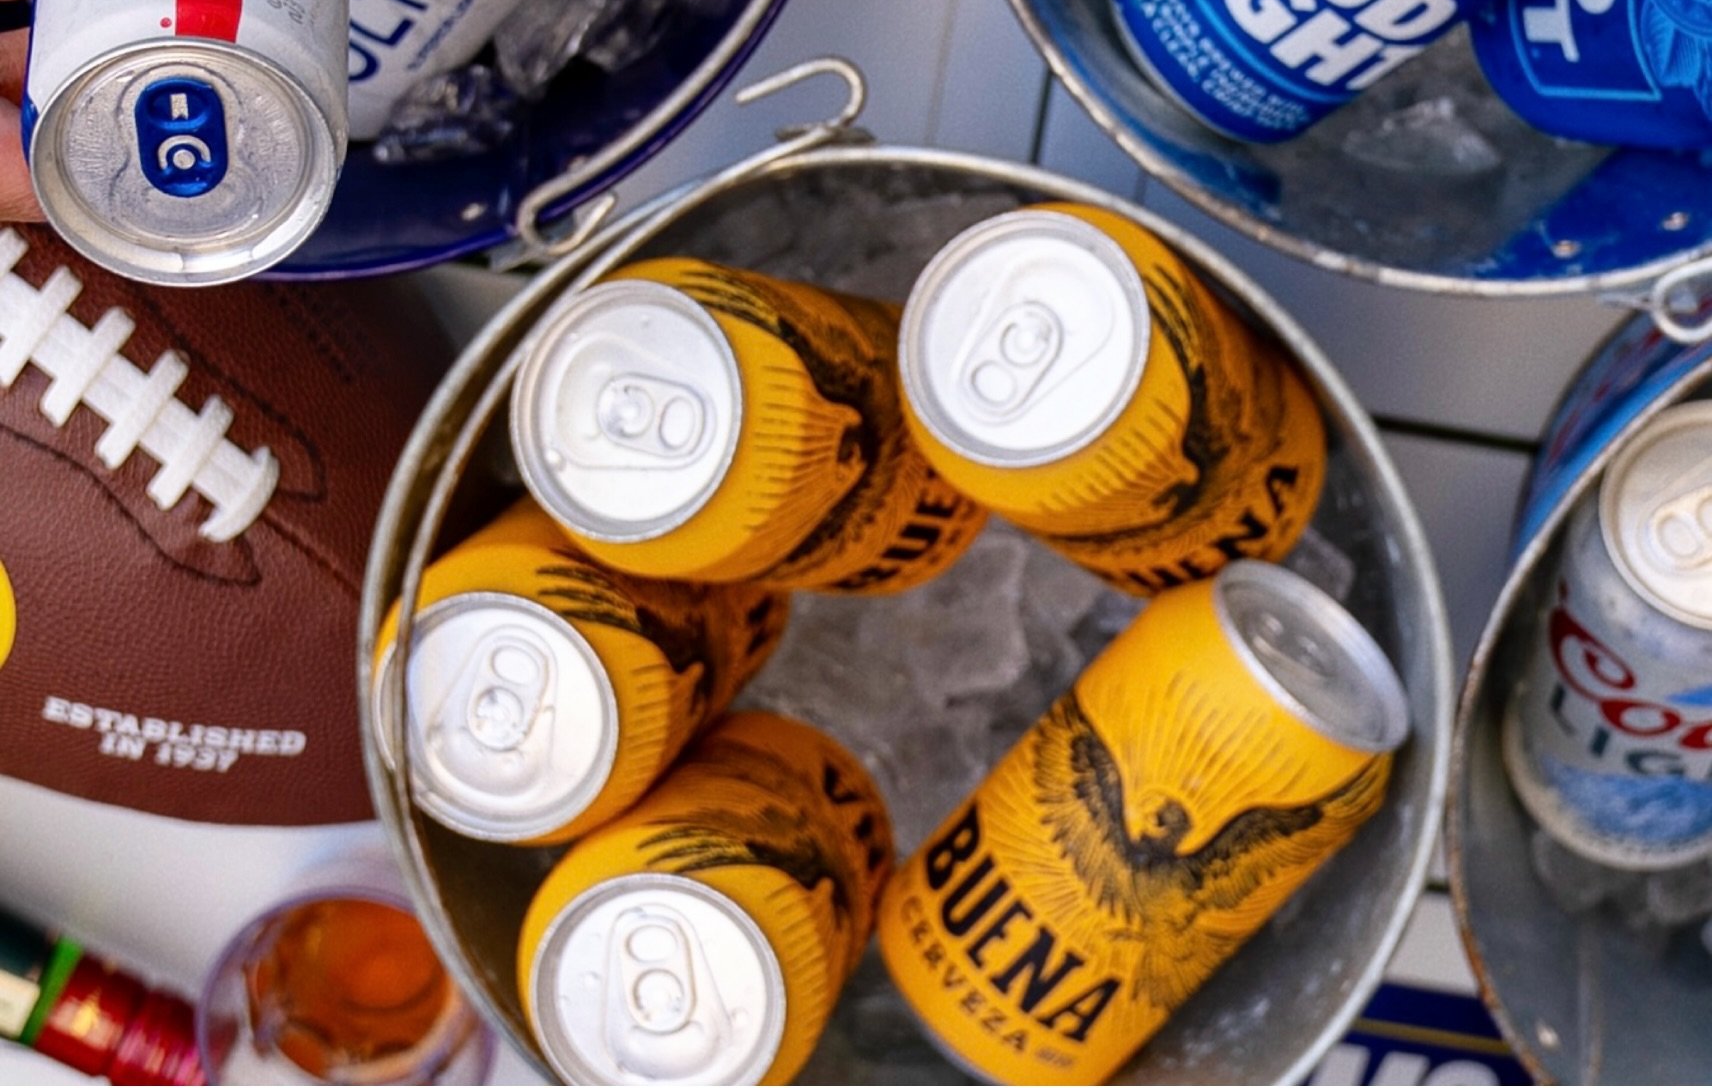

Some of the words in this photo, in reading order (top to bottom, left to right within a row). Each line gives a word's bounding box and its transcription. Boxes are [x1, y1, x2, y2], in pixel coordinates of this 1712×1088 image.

[832, 488, 962, 591] BUE
[1104, 465, 1299, 597] UENA
[42, 695, 307, 757] ESTABLISHED
[99, 732, 146, 762] IN
[155, 742, 239, 774] 1937
[1551, 682, 1712, 780] LIG
[925, 799, 1122, 1044] BUENA
[902, 895, 1032, 1053] CERVEZA
